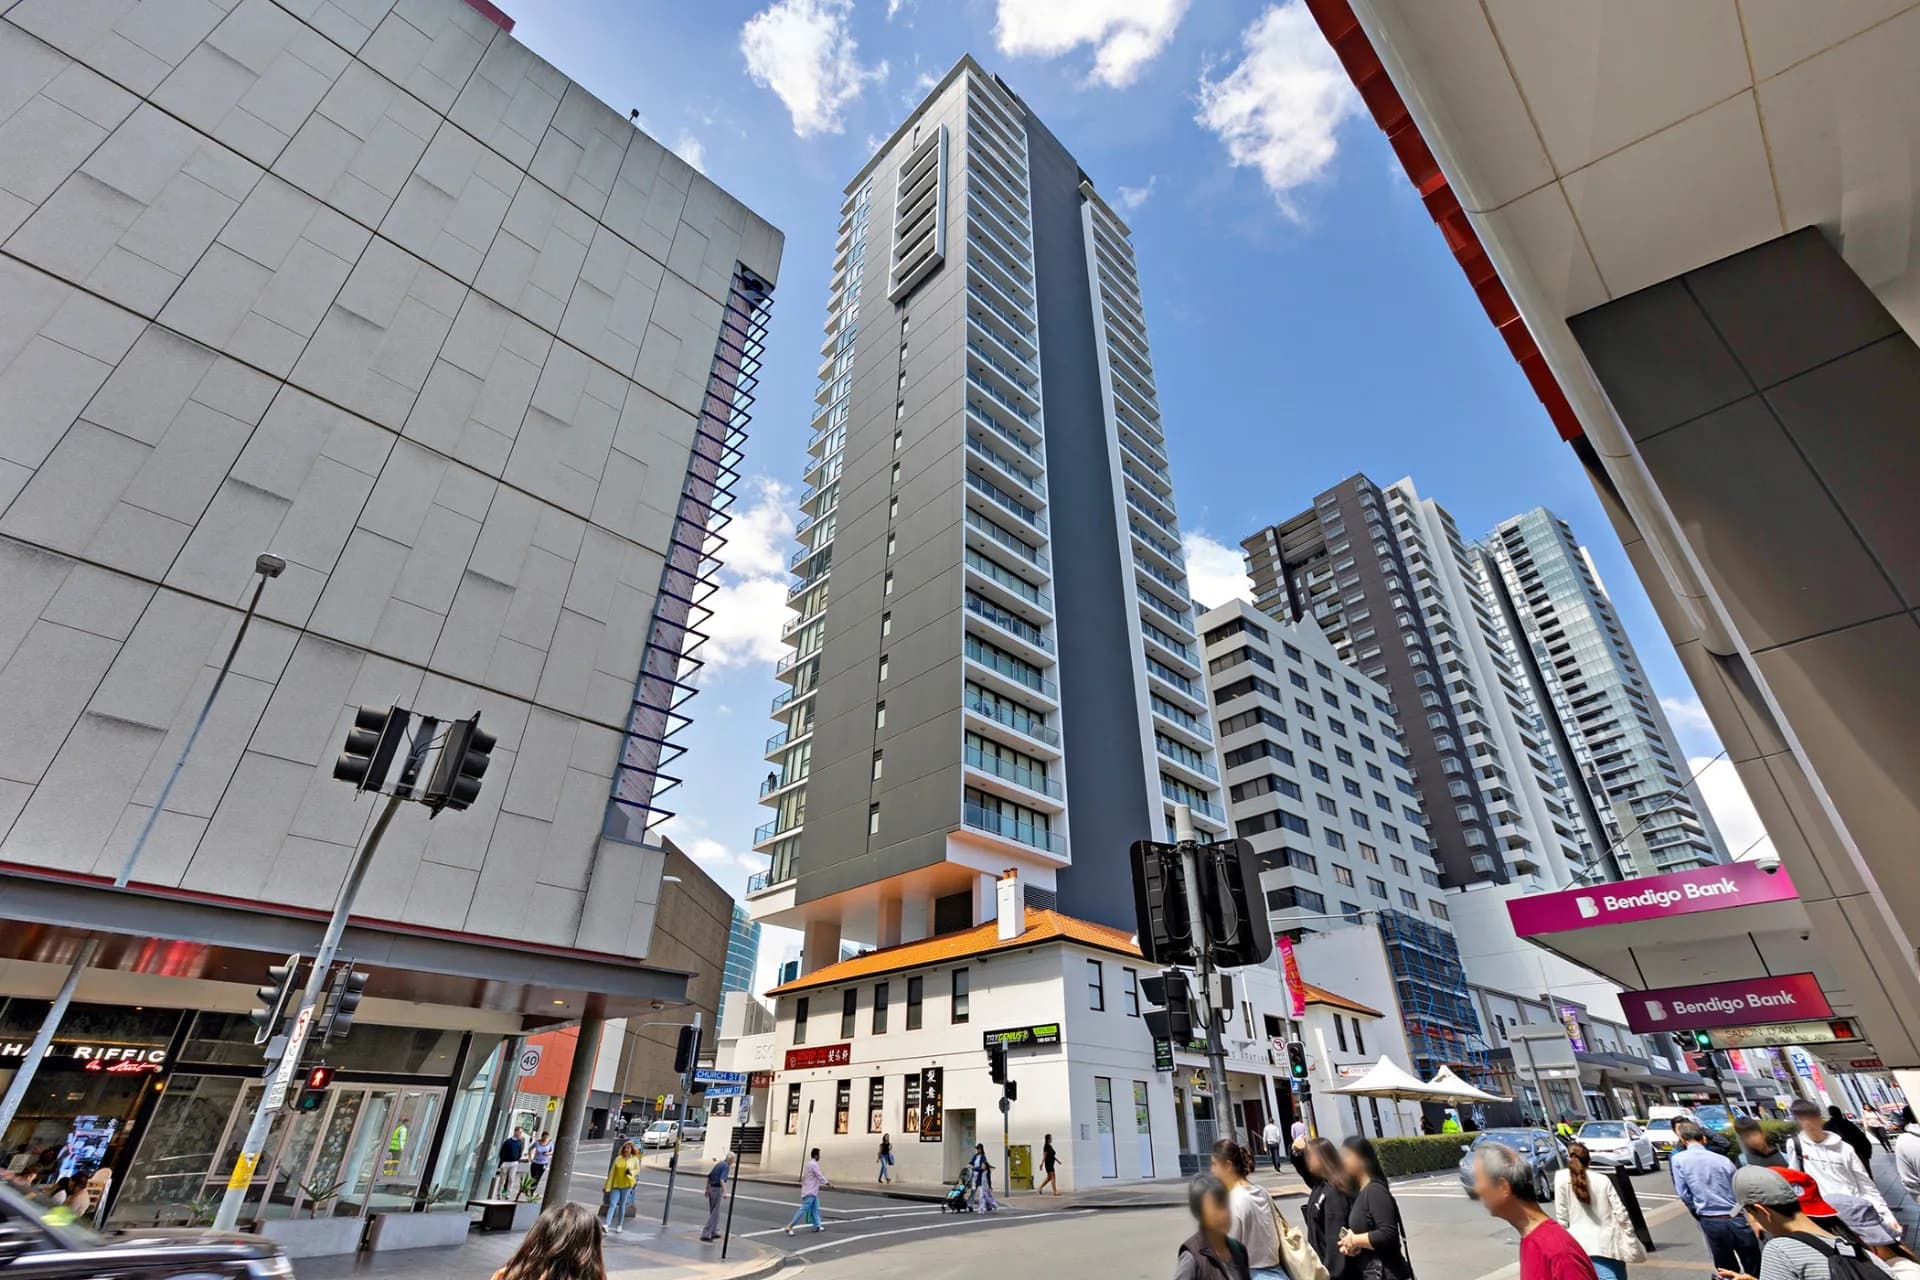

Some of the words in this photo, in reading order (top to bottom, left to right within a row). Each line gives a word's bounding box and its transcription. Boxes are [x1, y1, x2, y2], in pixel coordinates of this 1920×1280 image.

[1603, 888, 1682, 911] Bendigo
[1683, 877, 1739, 899] Bank
[1672, 997, 1744, 1015] Bendigo
[1746, 990, 1797, 1008] Bank
[1725, 1027, 1763, 1039] SALON
[0, 1043, 55, 1058] HI
[73, 1046, 167, 1062] RIFFIC
[523, 1055, 537, 1066] 40
[696, 1071, 727, 1079] CHURCH
